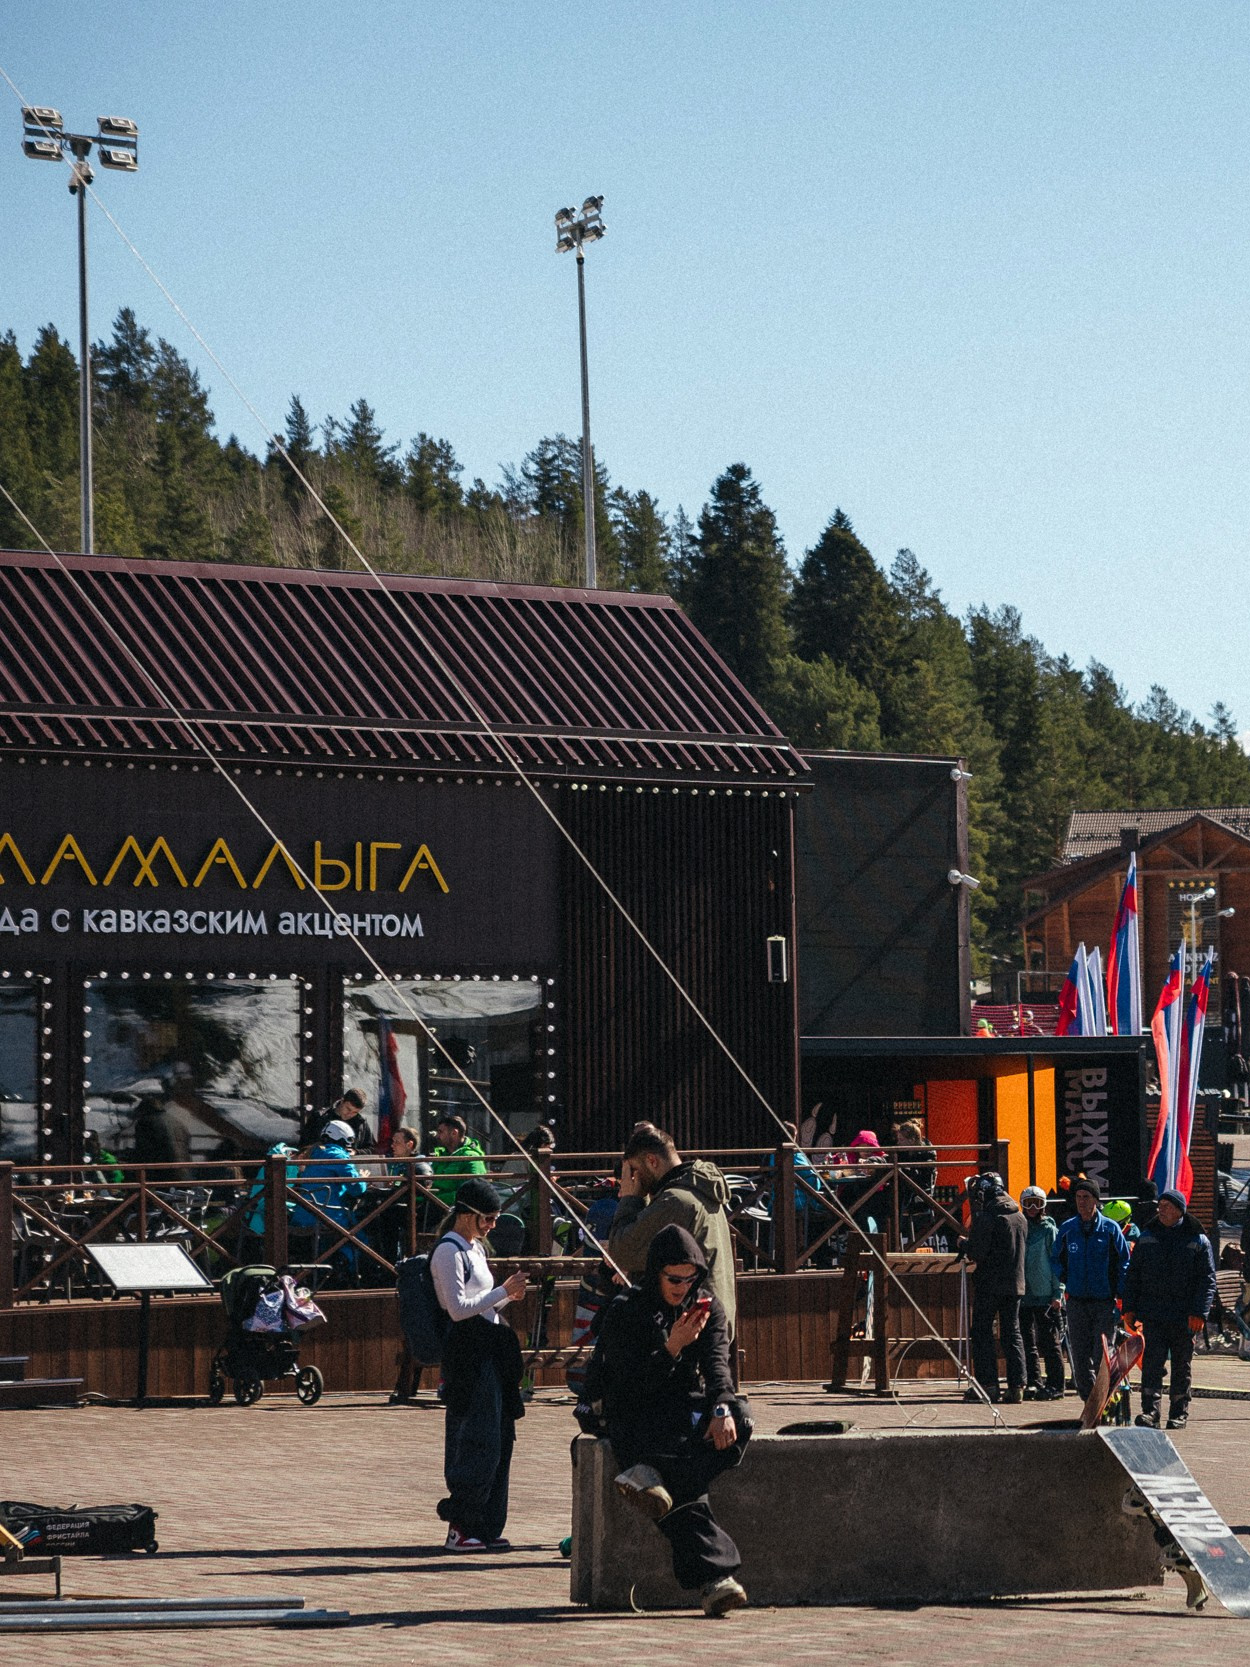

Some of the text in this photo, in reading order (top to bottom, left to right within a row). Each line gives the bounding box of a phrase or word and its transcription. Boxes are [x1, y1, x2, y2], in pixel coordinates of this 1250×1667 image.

[51, 908, 70, 933] с
[83, 908, 268, 935] кавказским
[278, 910, 425, 939] акцентом
[1131, 1472, 1233, 1538] CREW
[46, 1521, 90, 1531] ФЕДЕРАЦИЯ
[46, 1531, 90, 1541] ФРИСТАЙЛА
